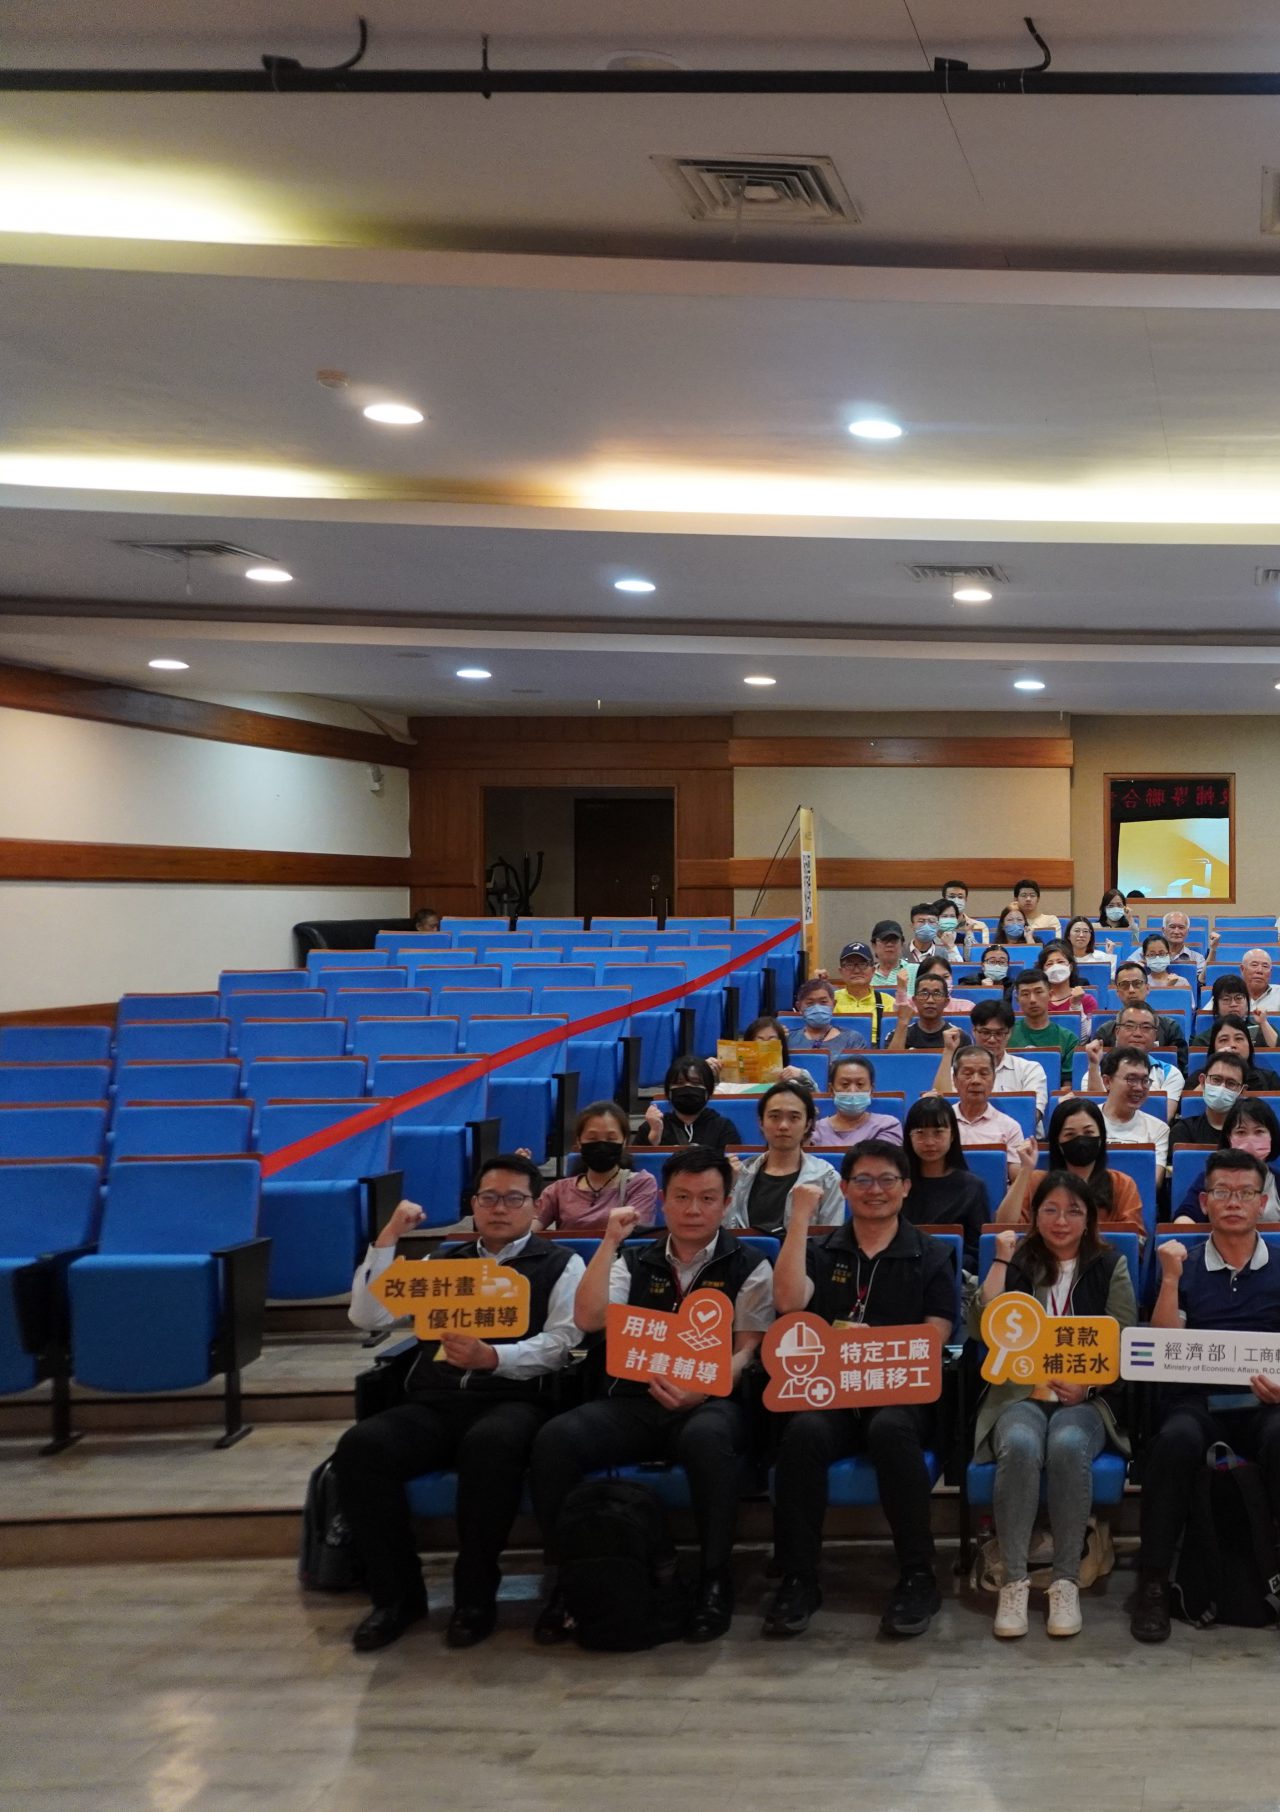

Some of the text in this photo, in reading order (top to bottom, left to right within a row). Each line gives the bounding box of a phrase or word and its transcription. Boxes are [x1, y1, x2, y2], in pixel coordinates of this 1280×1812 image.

[384, 1276, 475, 1298] 改善計畫
[428, 1306, 518, 1329] 優化輔導
[622, 1315, 668, 1342] 用地
[1054, 1326, 1099, 1347] 貸款
[840, 1338, 930, 1365] 特定工廠
[1164, 1341, 1226, 1362] 經濟部
[625, 1347, 719, 1384] 計畫輔導
[1043, 1353, 1110, 1374] 補活水
[1164, 1363, 1192, 1372] Ministry
[1201, 1365, 1236, 1373] Economic
[840, 1366, 930, 1392] 聘僱移工
